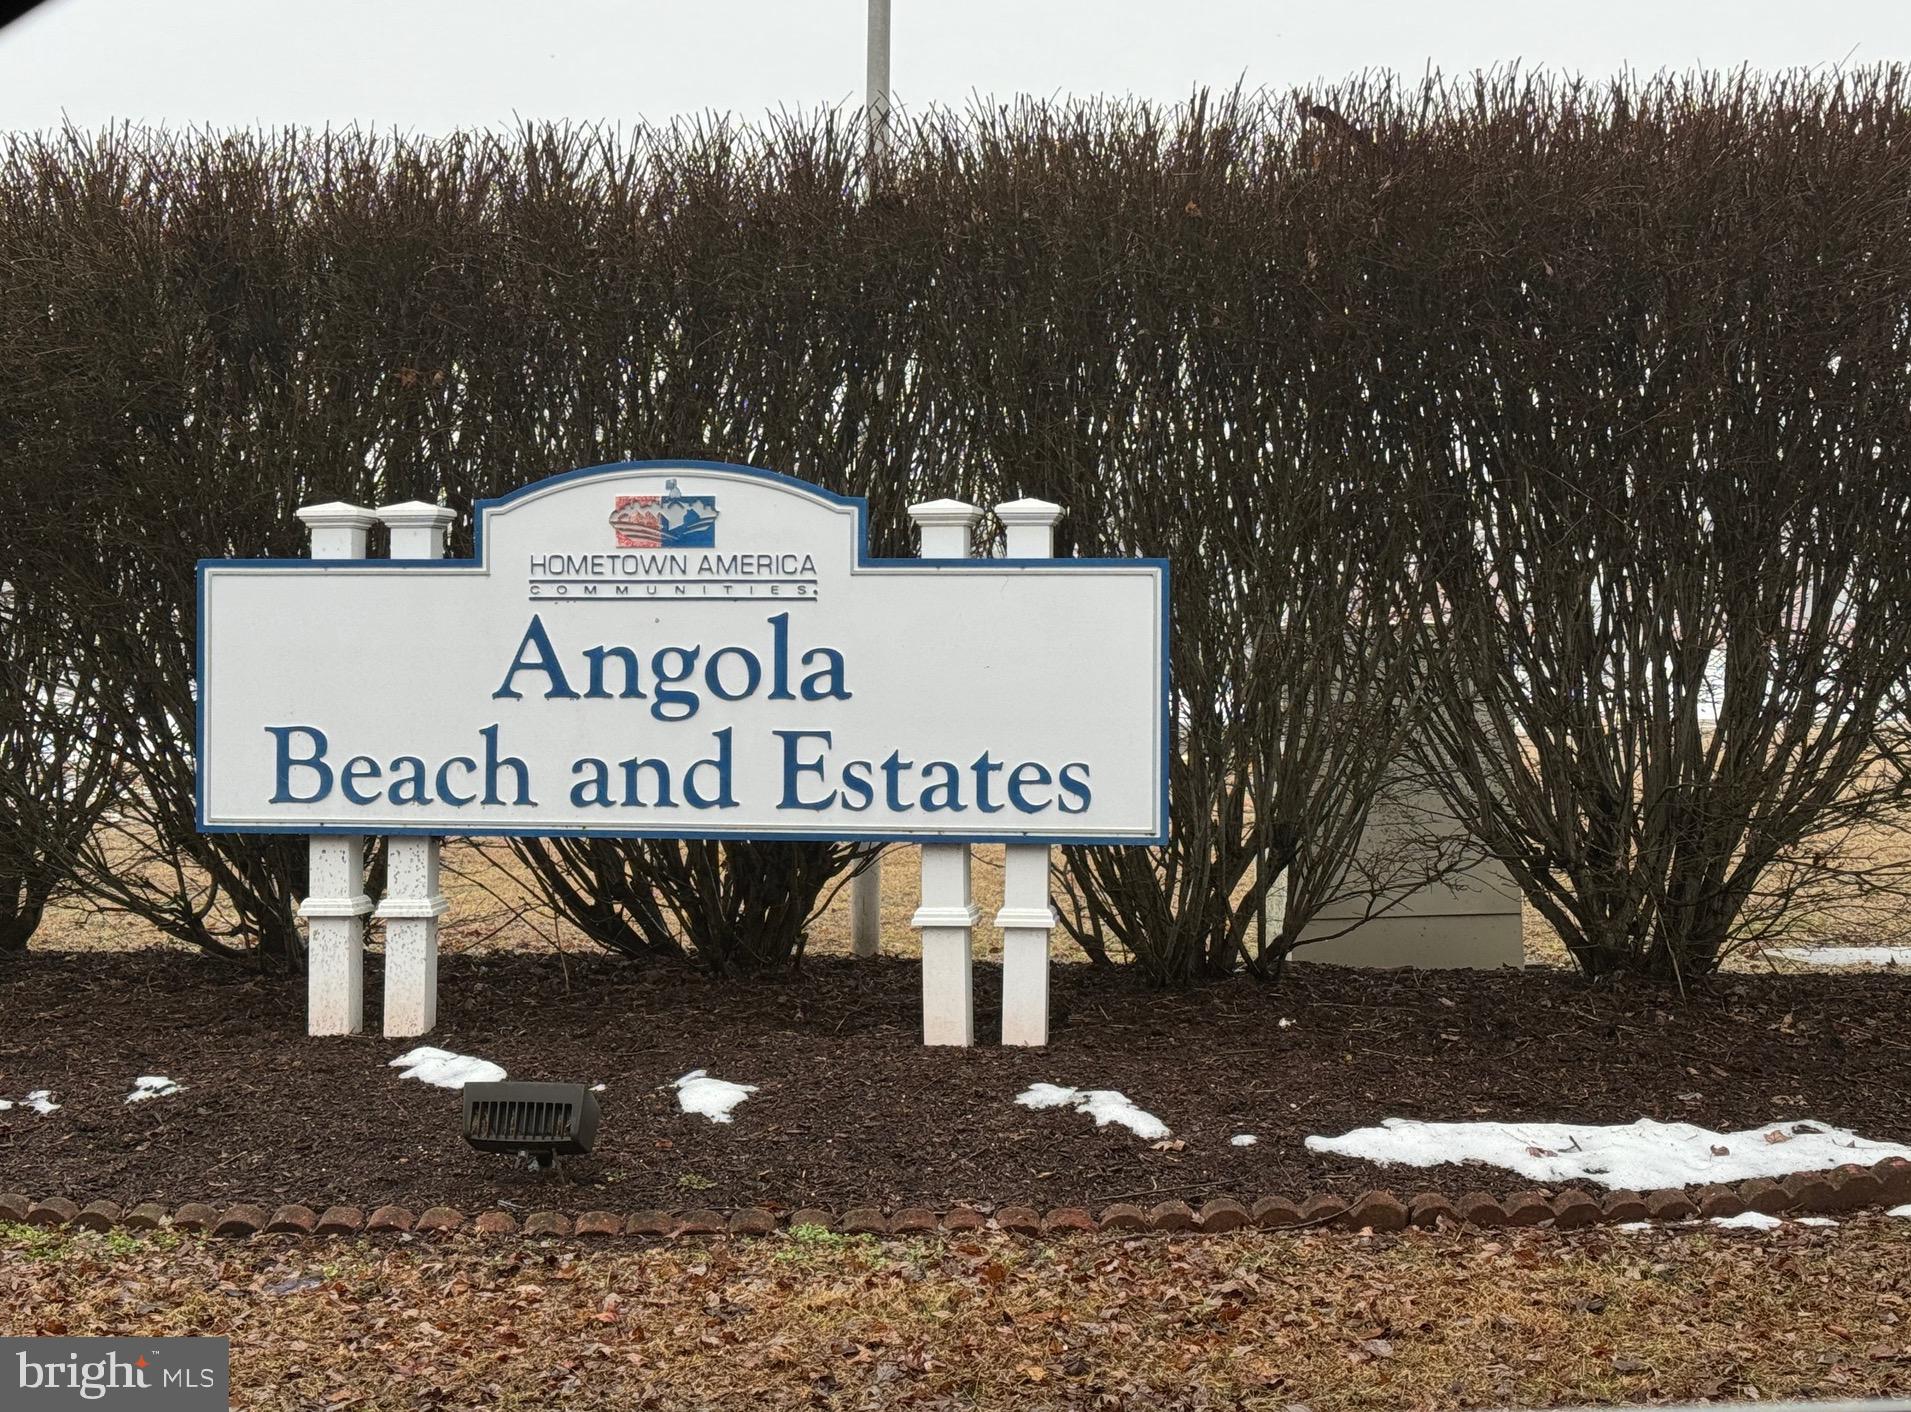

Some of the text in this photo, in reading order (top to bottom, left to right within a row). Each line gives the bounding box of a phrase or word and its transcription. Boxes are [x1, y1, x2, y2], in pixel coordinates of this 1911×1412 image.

[530, 554, 817, 576] HOMETOWN AMERICA
[492, 612, 853, 722] Angola
[264, 723, 1092, 814] Beach and Estates
